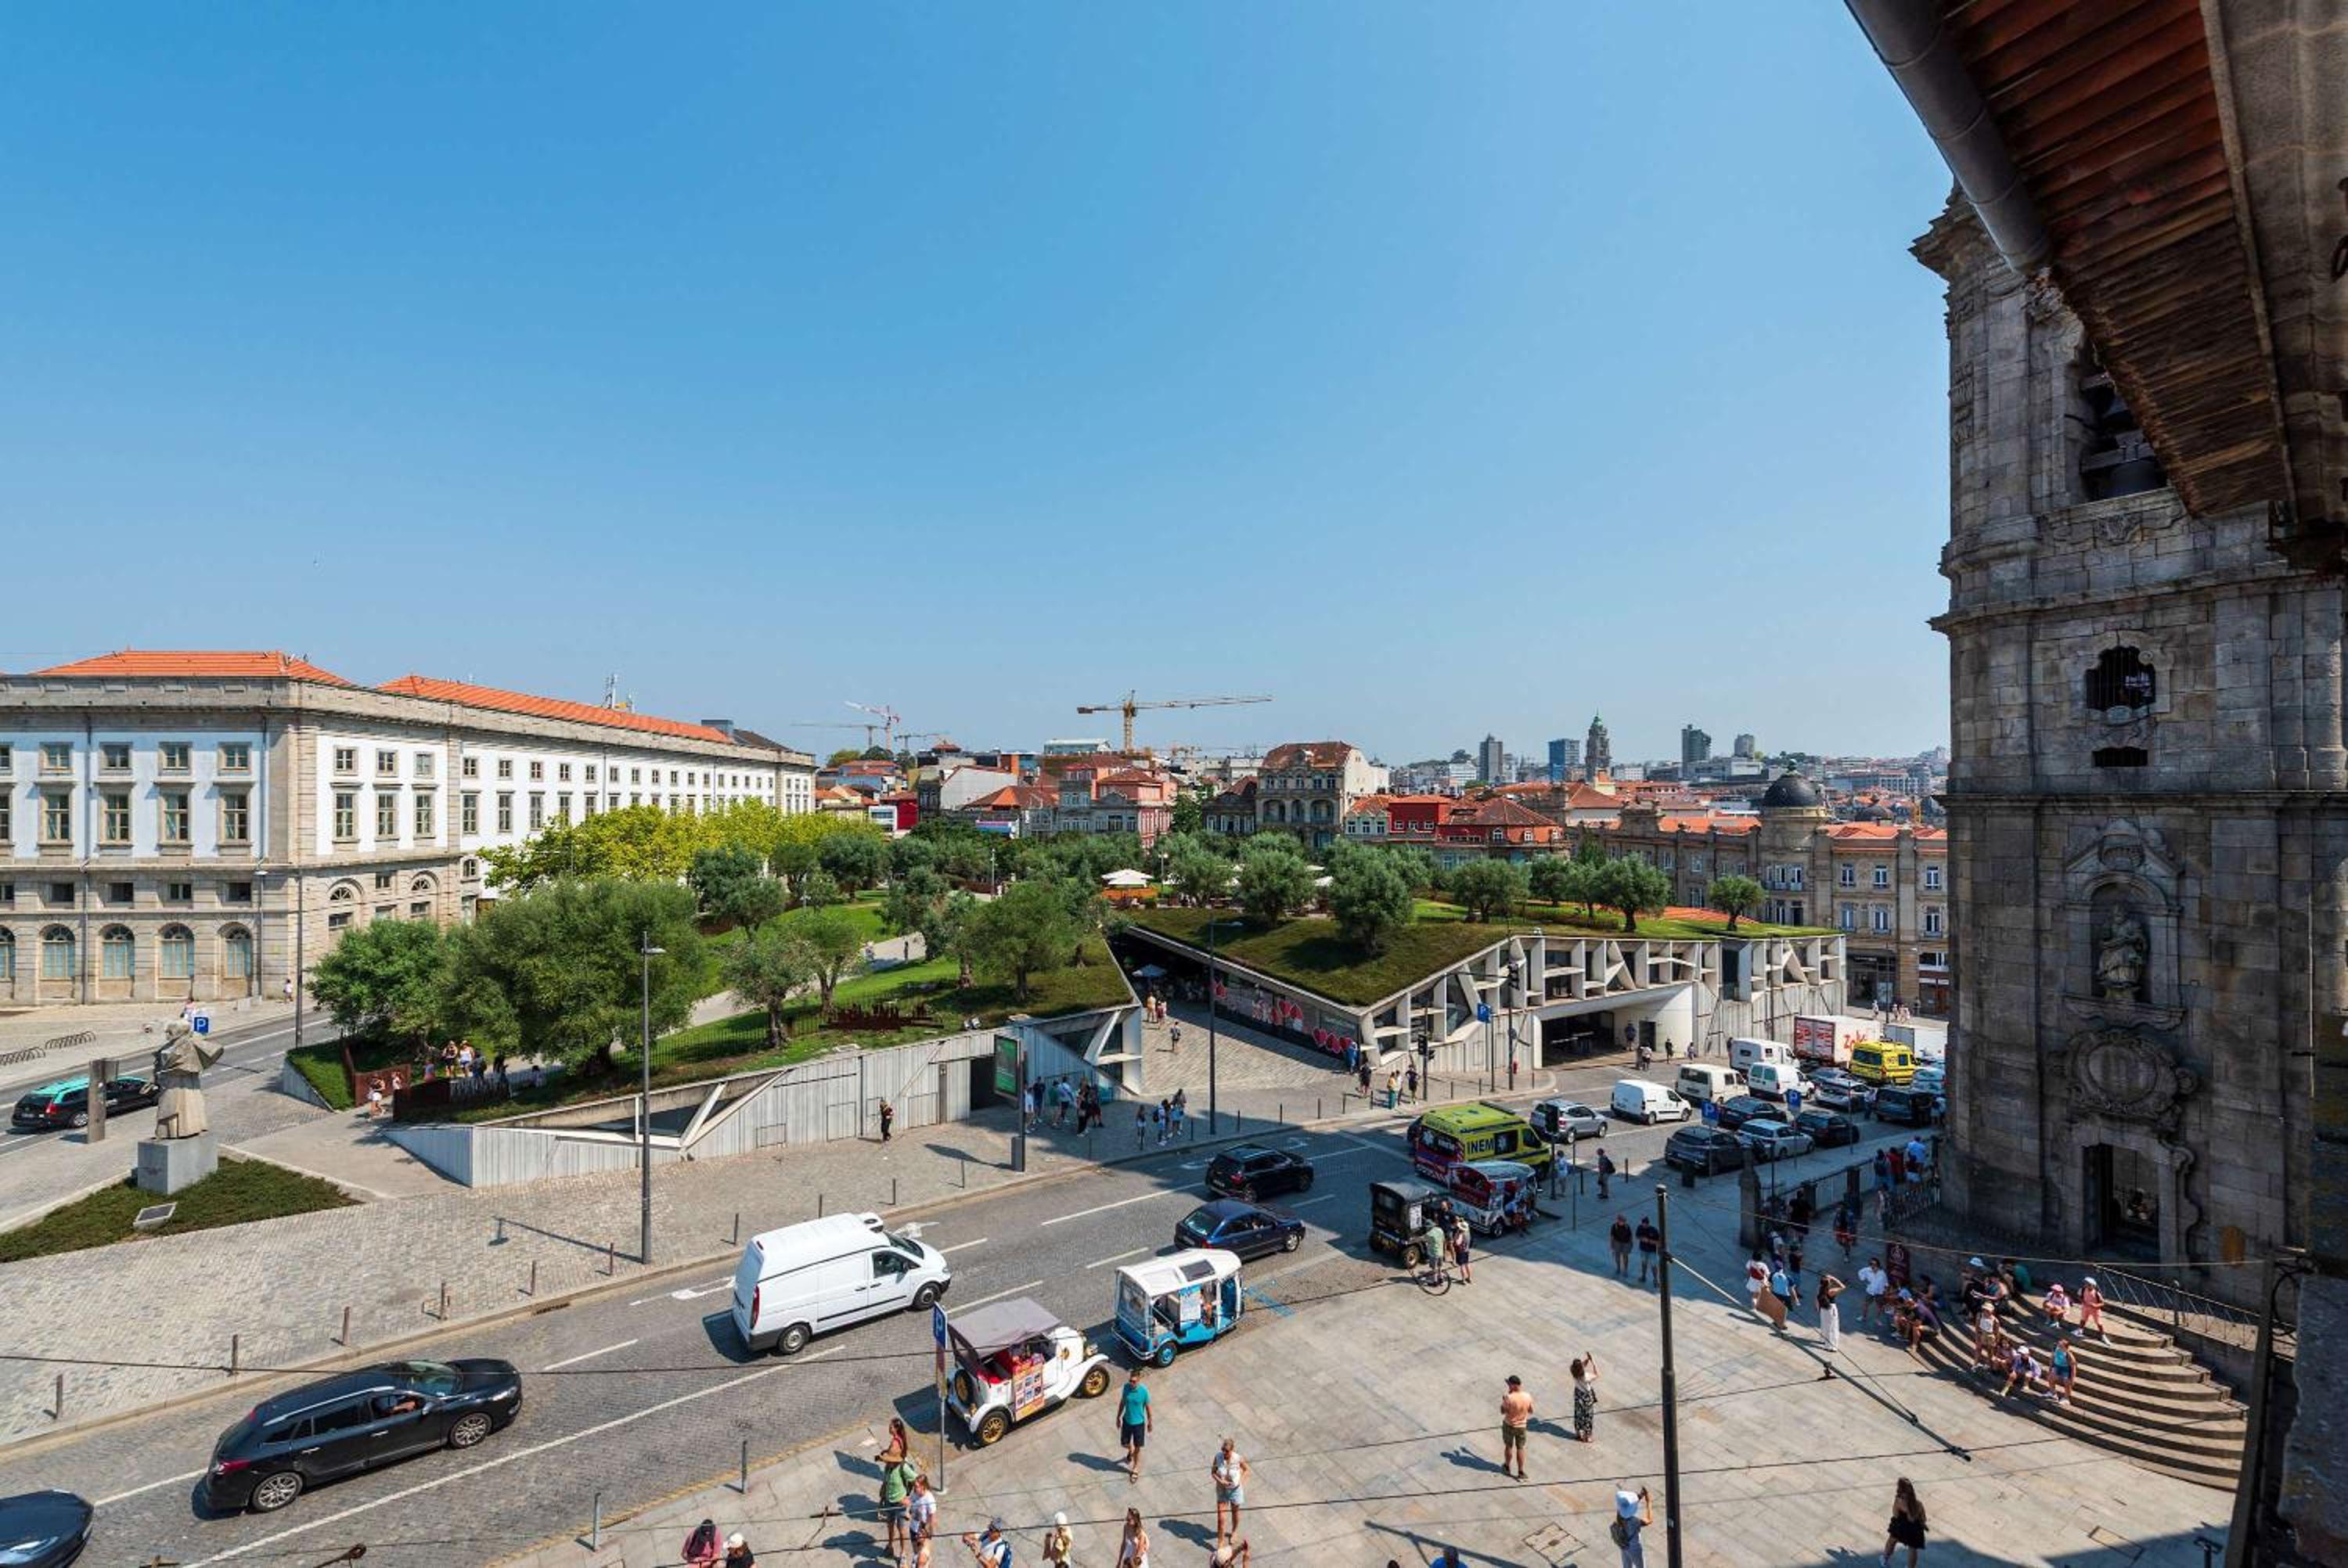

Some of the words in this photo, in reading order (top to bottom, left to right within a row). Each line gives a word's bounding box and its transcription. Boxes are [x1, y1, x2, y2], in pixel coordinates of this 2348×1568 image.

[1480, 1005, 1486, 1015] P
[196, 1018, 207, 1032] P
[1788, 1090, 1798, 1101] P
[1704, 1103, 1715, 1116] P
[1466, 1138, 1494, 1154] INEM
